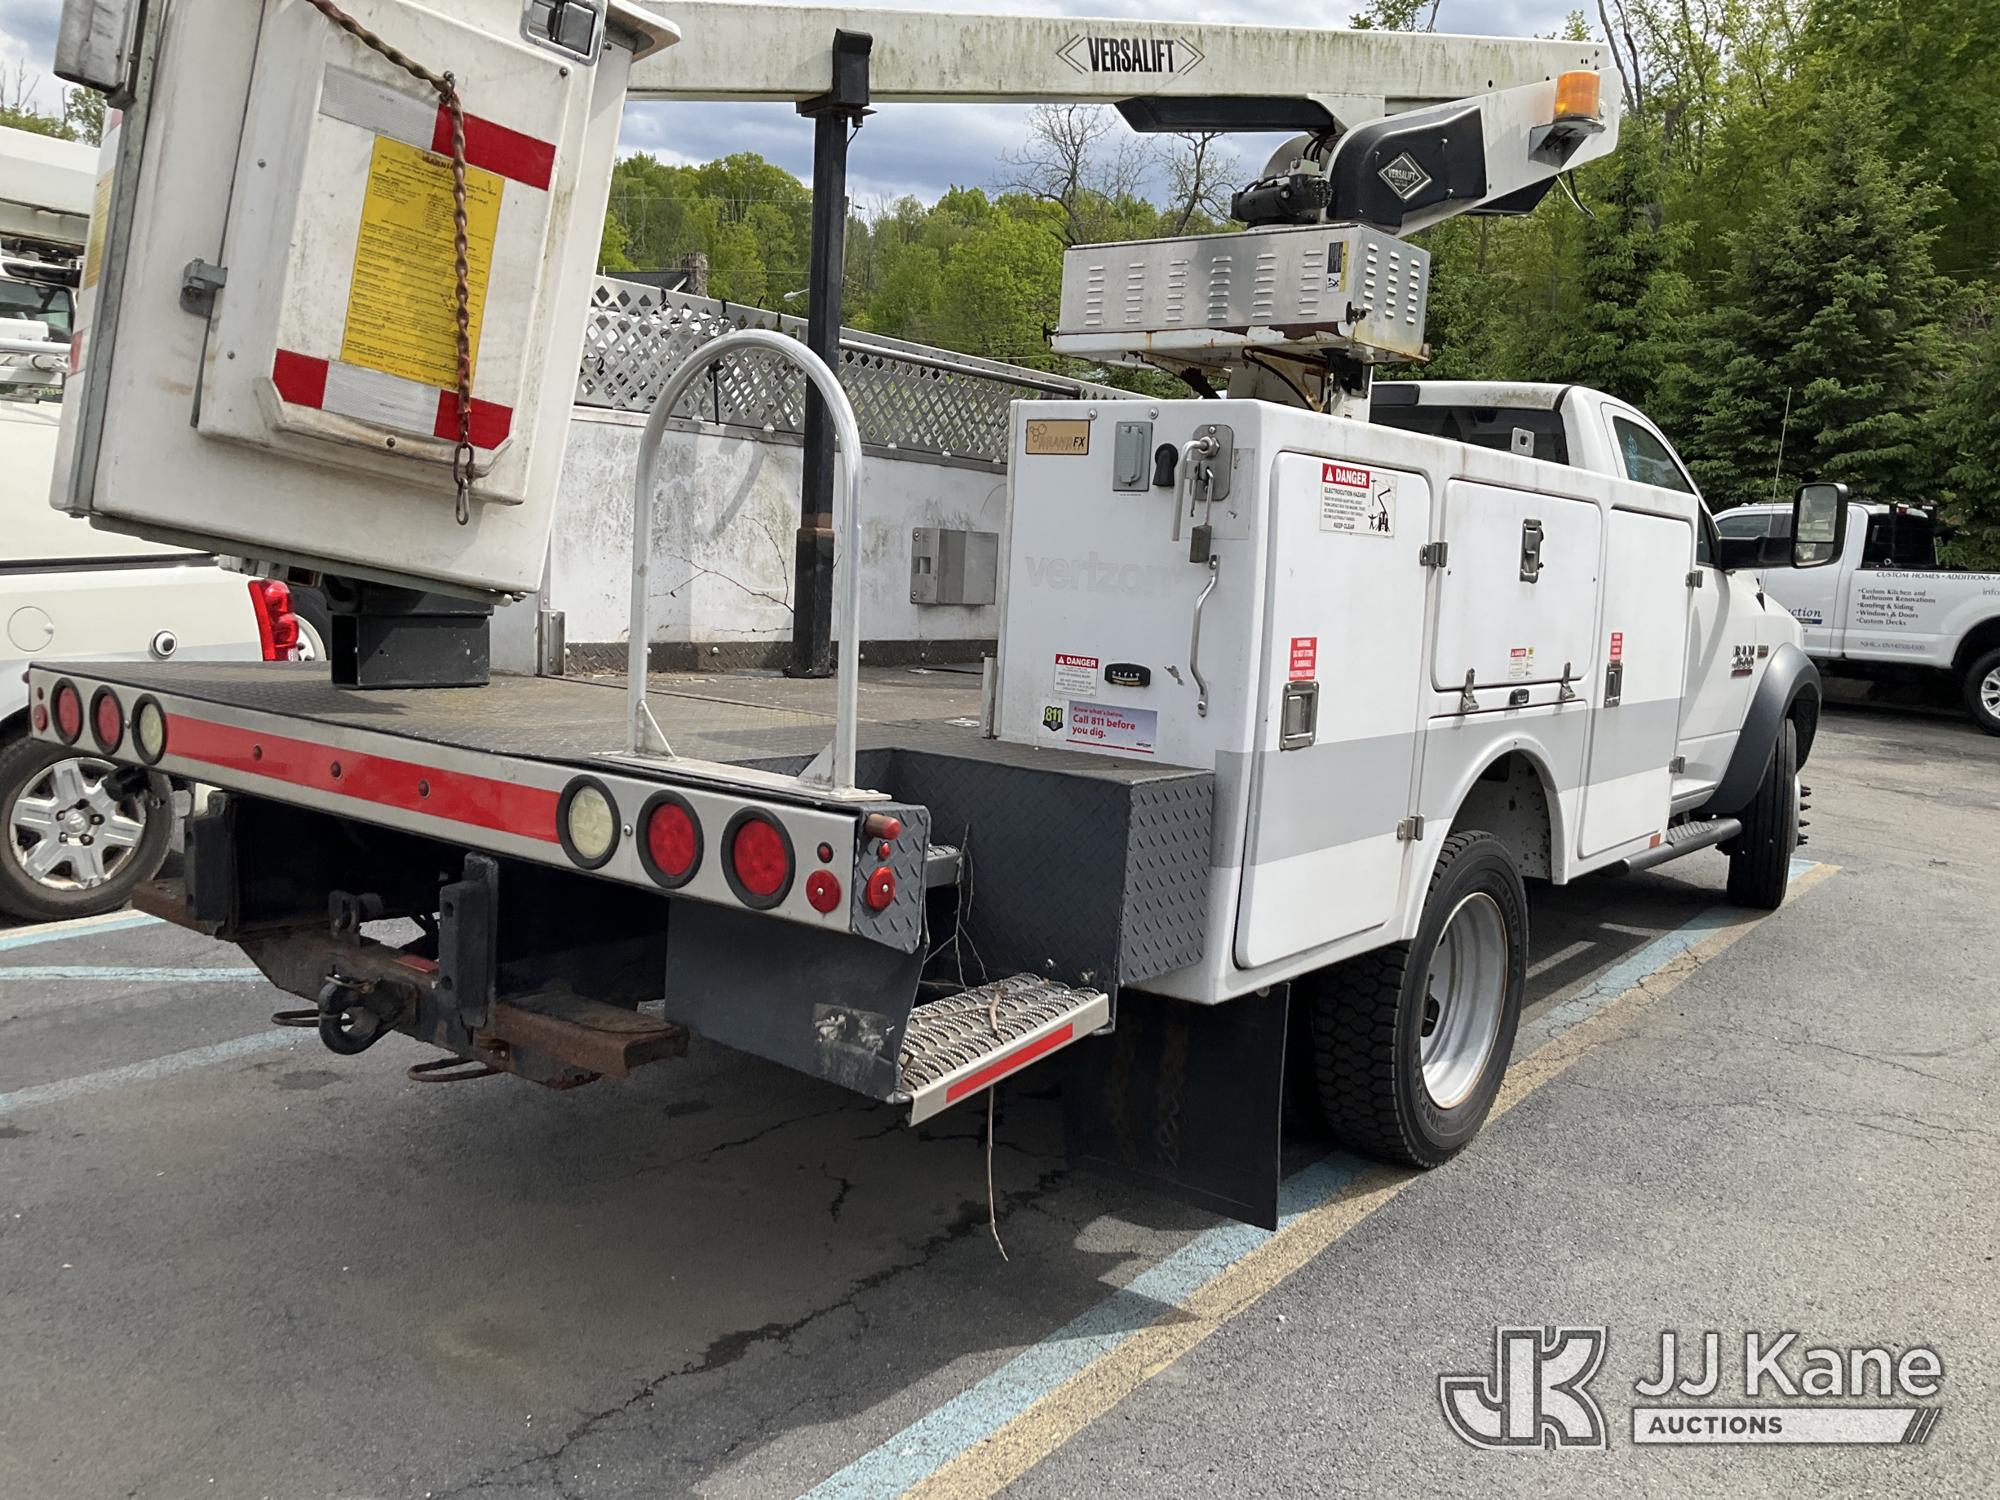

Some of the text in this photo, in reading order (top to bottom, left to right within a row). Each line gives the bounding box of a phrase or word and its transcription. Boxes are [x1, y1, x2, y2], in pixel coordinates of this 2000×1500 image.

[1087, 37, 1174, 73] VERSALIFT
[1335, 468, 1367, 487] DANGER
[1859, 602, 1885, 610] Roofing
[1893, 603, 1914, 611] Siding
[1895, 596, 1936, 604] Renovations
[1859, 617, 1906, 626] Custom Decks
[1066, 658, 1096, 668] DANGER
[1045, 706, 1063, 722] 811
[1073, 714, 1136, 730] Call 811 before
[1072, 726, 1106, 739] you dig.
